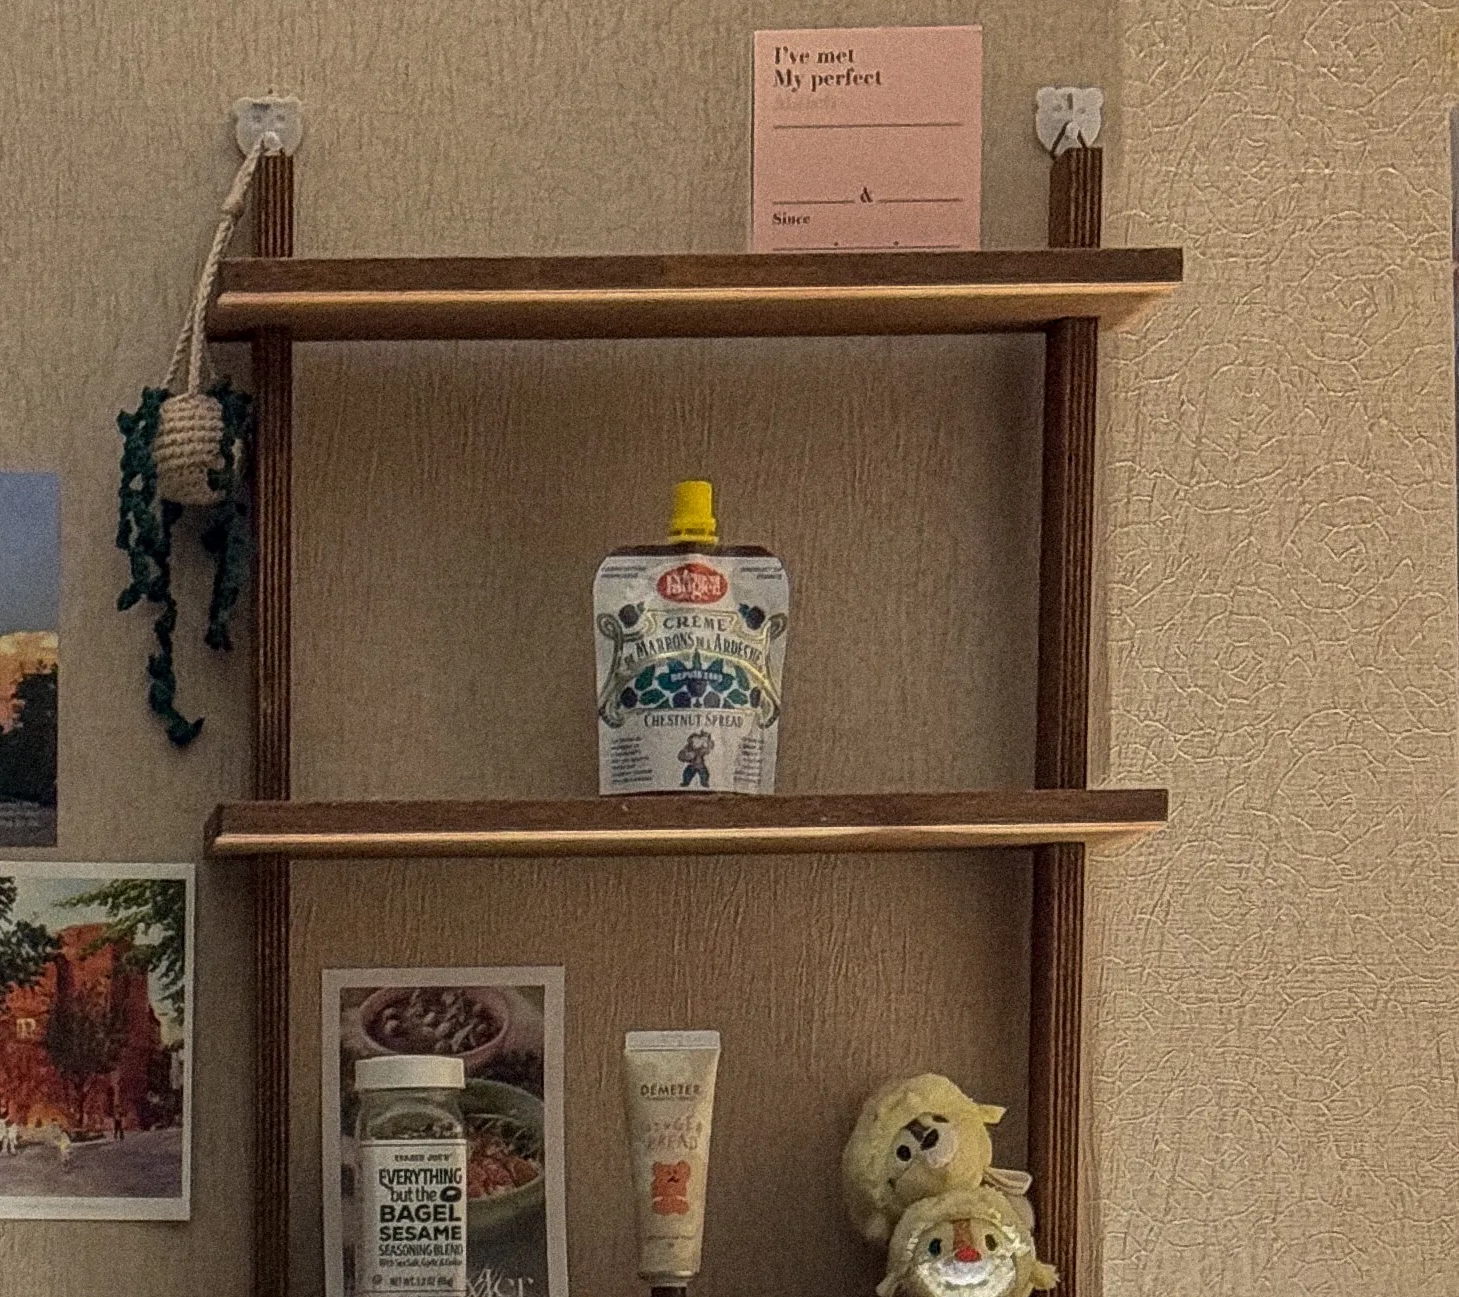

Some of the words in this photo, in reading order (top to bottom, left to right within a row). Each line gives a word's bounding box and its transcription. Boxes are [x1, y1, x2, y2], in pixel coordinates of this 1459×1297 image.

[774, 45, 810, 65] I've
[817, 48, 854, 64] met
[772, 68, 801, 93] My
[810, 66, 882, 92] perfect
[771, 211, 811, 225] Since
[643, 713, 702, 728] CHESTNUT
[705, 713, 744, 728] SPREAD
[378, 1167, 463, 1186] EVERYTHING
[390, 1185, 414, 1202] but
[415, 1185, 438, 1202] the
[379, 1203, 463, 1223] BAGEL
[378, 1225, 463, 1242] SESAME
[378, 1243, 433, 1257] SEASONING
[433, 1243, 464, 1257] BLEND
